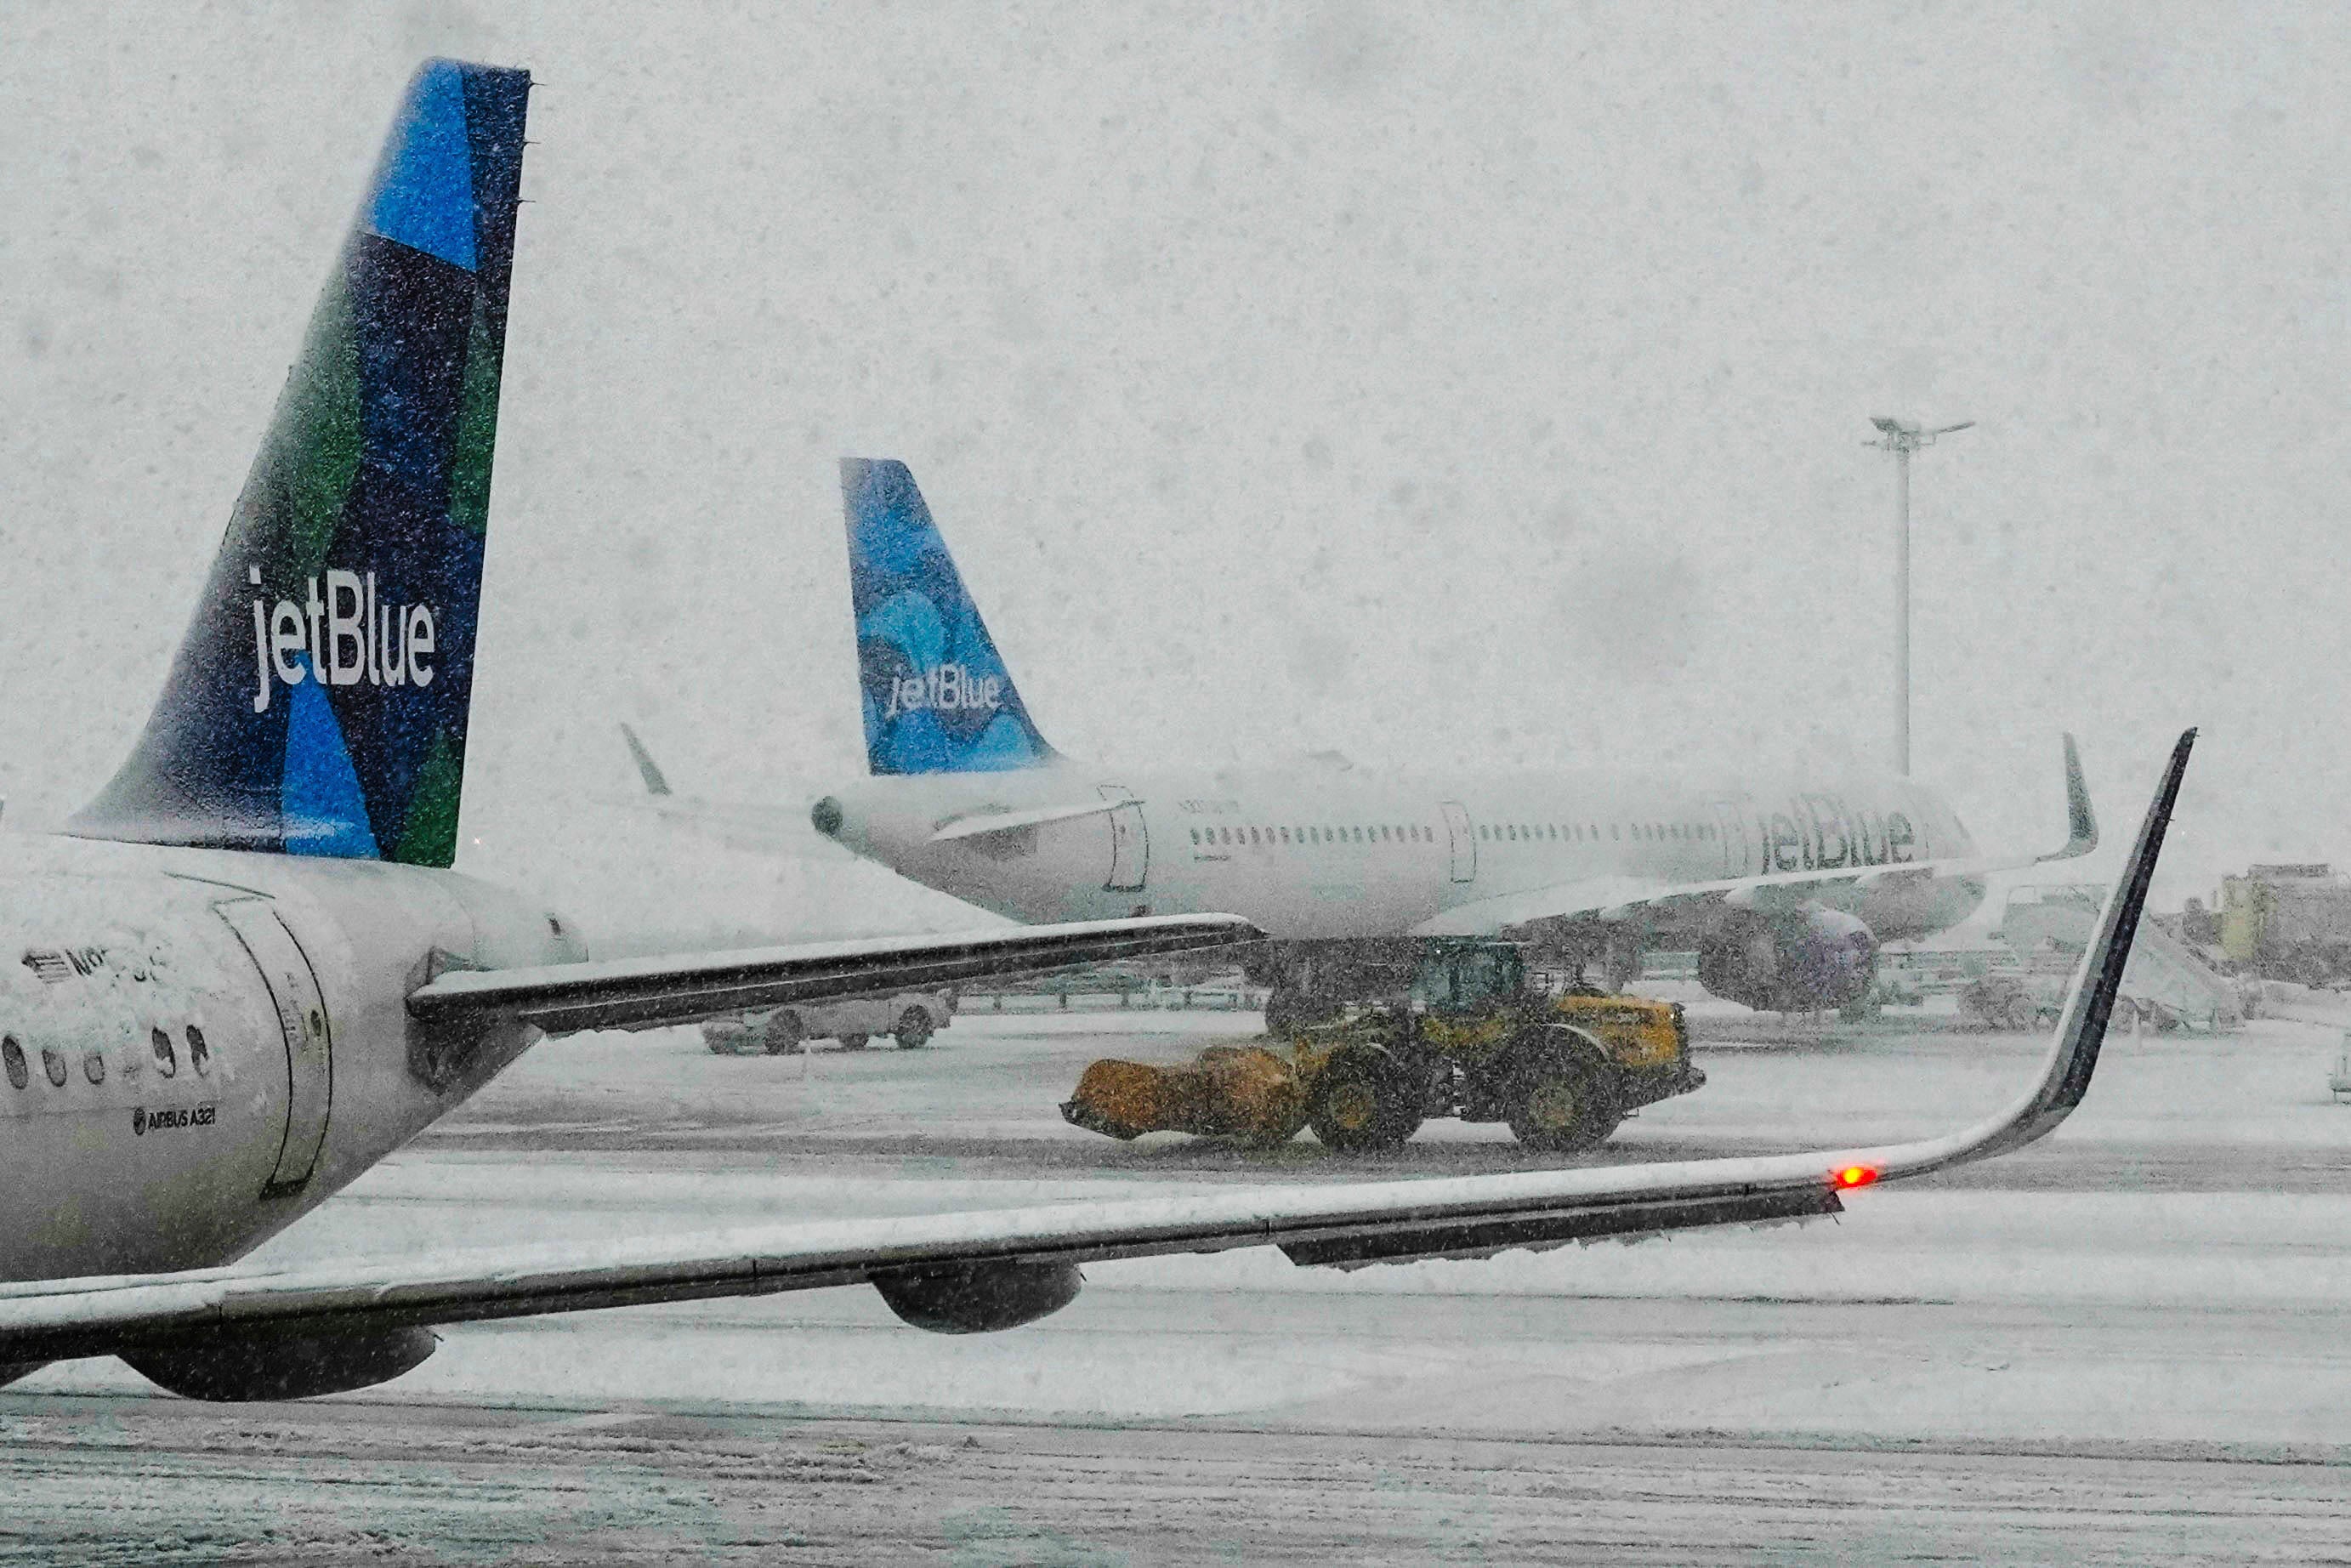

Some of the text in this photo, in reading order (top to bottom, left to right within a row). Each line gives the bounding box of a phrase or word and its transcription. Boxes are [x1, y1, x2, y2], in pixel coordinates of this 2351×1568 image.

[249, 565, 435, 713] jetBlue
[885, 662, 1001, 719] jetBlue
[148, 1107, 215, 1129] AIRBUS A321
